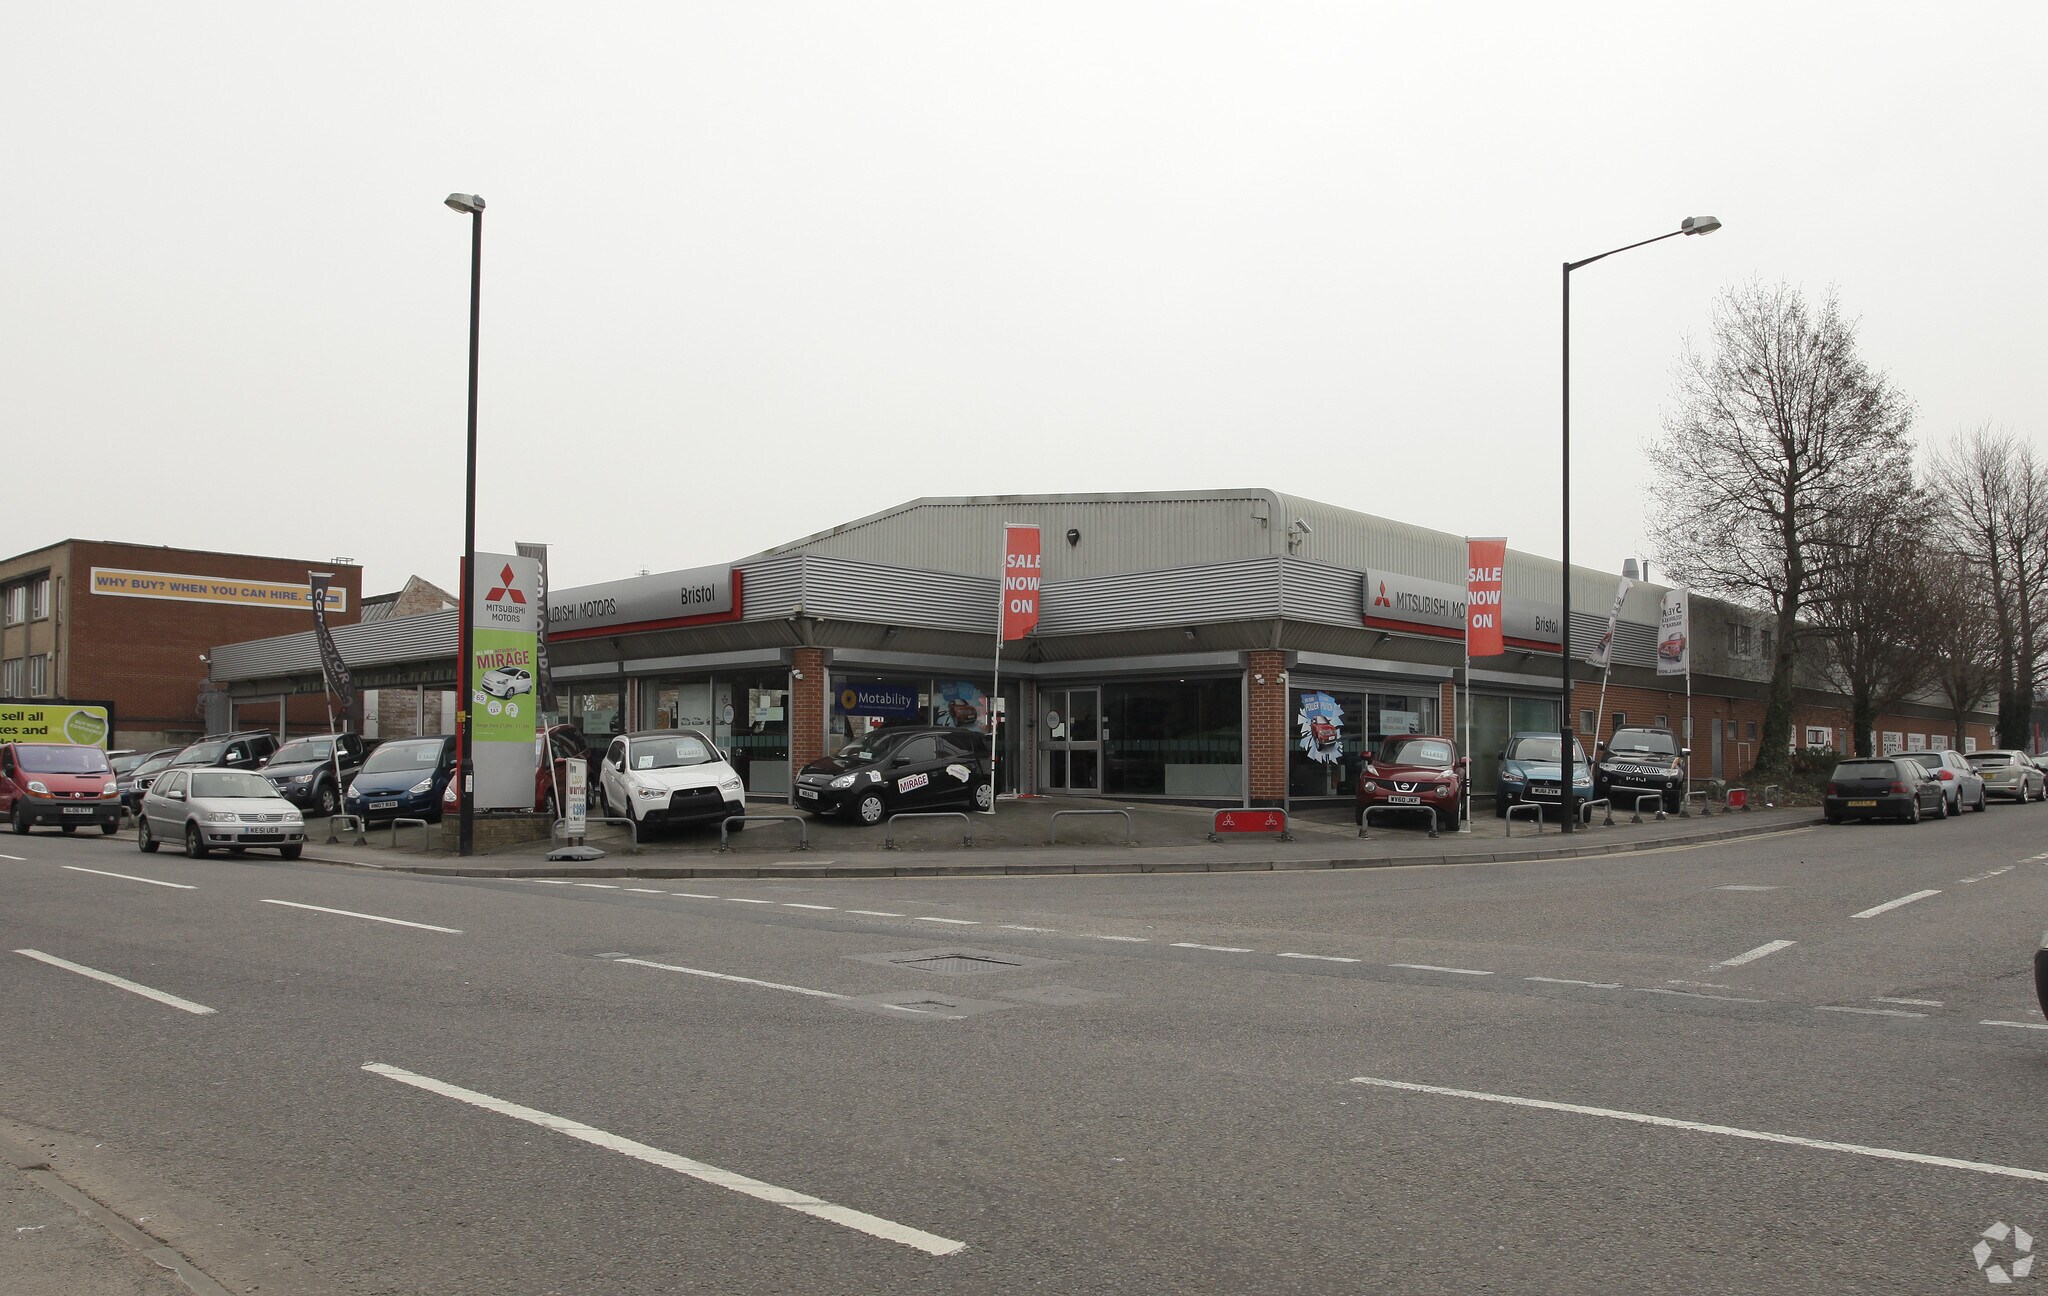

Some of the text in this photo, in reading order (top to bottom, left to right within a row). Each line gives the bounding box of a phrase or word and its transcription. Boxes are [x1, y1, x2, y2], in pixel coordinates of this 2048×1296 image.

[1007, 554, 1040, 568] SALE
[1468, 567, 1502, 582] SALE
[97, 576, 127, 588] WHY
[131, 579, 166, 590] BUY?
[170, 582, 207, 594] WHEN
[211, 585, 238, 596] YOU
[241, 587, 267, 598] CAN
[270, 589, 302, 601] HIRE.
[1005, 576, 1040, 591] NOW
[681, 583, 715, 605] Bristol
[1468, 590, 1502, 606] NOW
[485, 603, 526, 614] MITSUBISHI
[548, 598, 617, 623] UBISHI MOTORS
[1010, 599, 1033, 614] ON
[1395, 592, 1449, 617] MITSUBISHI
[491, 613, 521, 623] MOTORS
[1472, 613, 1493, 629] ON
[1535, 615, 1559, 634] Bristol
[476, 650, 530, 670] MIRAGE
[858, 692, 912, 708] Motability
[1, 711, 44, 721] sell all
[22, 725, 49, 736] and
[899, 774, 928, 792] MIRAGE
